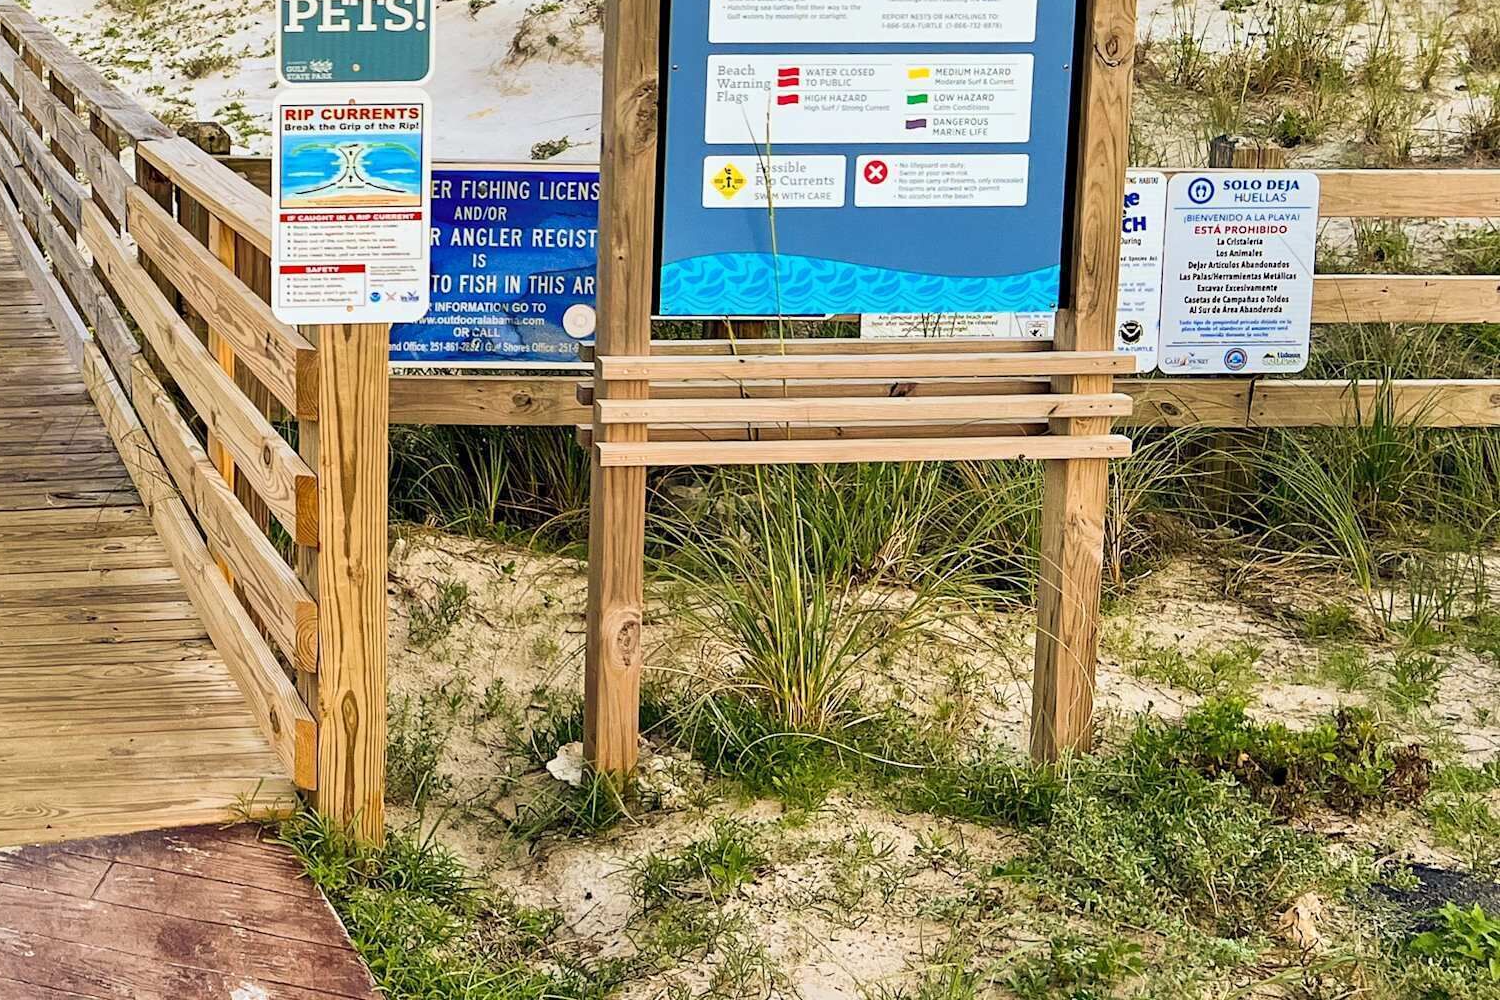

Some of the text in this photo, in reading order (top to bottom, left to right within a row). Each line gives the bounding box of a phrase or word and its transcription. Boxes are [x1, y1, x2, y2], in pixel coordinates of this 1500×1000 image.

[717, 63, 756, 76] Beach
[805, 67, 875, 77] WATER CLOSED
[935, 68, 1011, 76] MEDIUM HAZARD
[716, 78, 771, 91] Warning
[805, 78, 852, 87] TO PUBLIC
[716, 90, 749, 105] Flags
[804, 94, 867, 103] HIGH HAZARD
[934, 93, 995, 102] LOW HAZARD
[285, 107, 419, 121] RIP CURRENTS
[339, 123, 361, 131] Grip
[399, 122, 419, 131] Rip!
[933, 117, 989, 126] DANGEROUS
[932, 127, 988, 136] MARINE LIFE
[756, 160, 806, 174] Possible
[780, 175, 835, 186] Currents
[1223, 180, 1300, 192] SOLO DEJA
[461, 180, 530, 200] FISHING
[1234, 192, 1287, 203] HUELLAS
[454, 206, 507, 221] AND/OR
[1254, 214, 1266, 222] LA
[1268, 213, 1300, 222] PLAYA!
[1194, 223, 1288, 235] ESTÁ PROHIBIDO
[450, 228, 522, 247] ANGLER
[1217, 238, 1225, 246] La
[1216, 249, 1262, 257] Los Animales
[472, 253, 487, 268] IS
[1188, 261, 1207, 271] Dejar
[1241, 260, 1290, 269] Abandonados
[432, 274, 452, 293] TO
[459, 274, 497, 294] FISH
[504, 275, 521, 294] IN
[528, 275, 565, 294] THIS
[572, 276, 595, 295] AR
[1184, 296, 1210, 304] Casetas
[1212, 295, 1221, 304] de
[1266, 295, 1289, 303] Toldos
[434, 301, 546, 313] INFORMATION GO TO
[1189, 306, 1197, 314] Al
[1198, 306, 1211, 314] Sur
[1212, 305, 1221, 314] de
[1239, 304, 1282, 313] Abanderada
[453, 327, 502, 338] OR CALL
